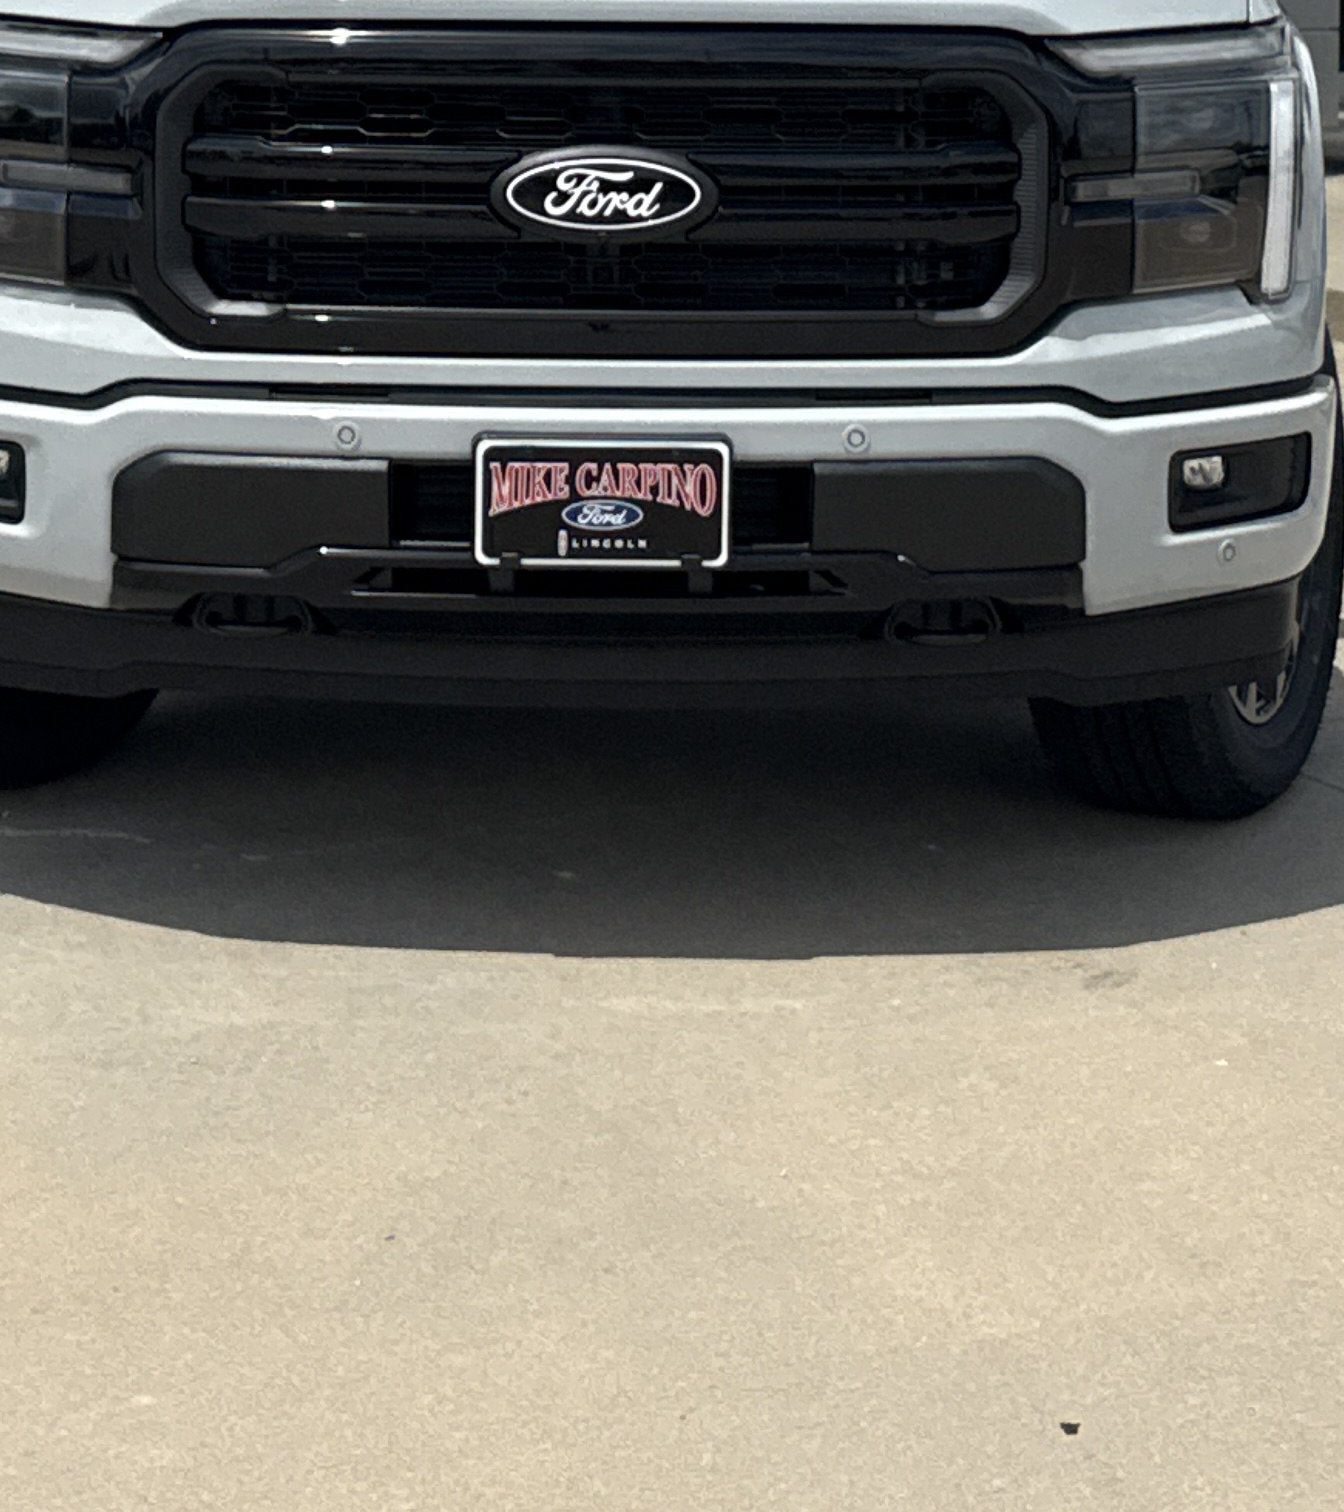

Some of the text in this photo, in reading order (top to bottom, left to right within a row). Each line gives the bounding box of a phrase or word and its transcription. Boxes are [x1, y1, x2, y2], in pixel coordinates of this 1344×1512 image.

[543, 167, 664, 217] Ford
[488, 461, 717, 517] MIKE CARPINO
[577, 504, 629, 525] Ford
[571, 539, 647, 549] LINCOLN
